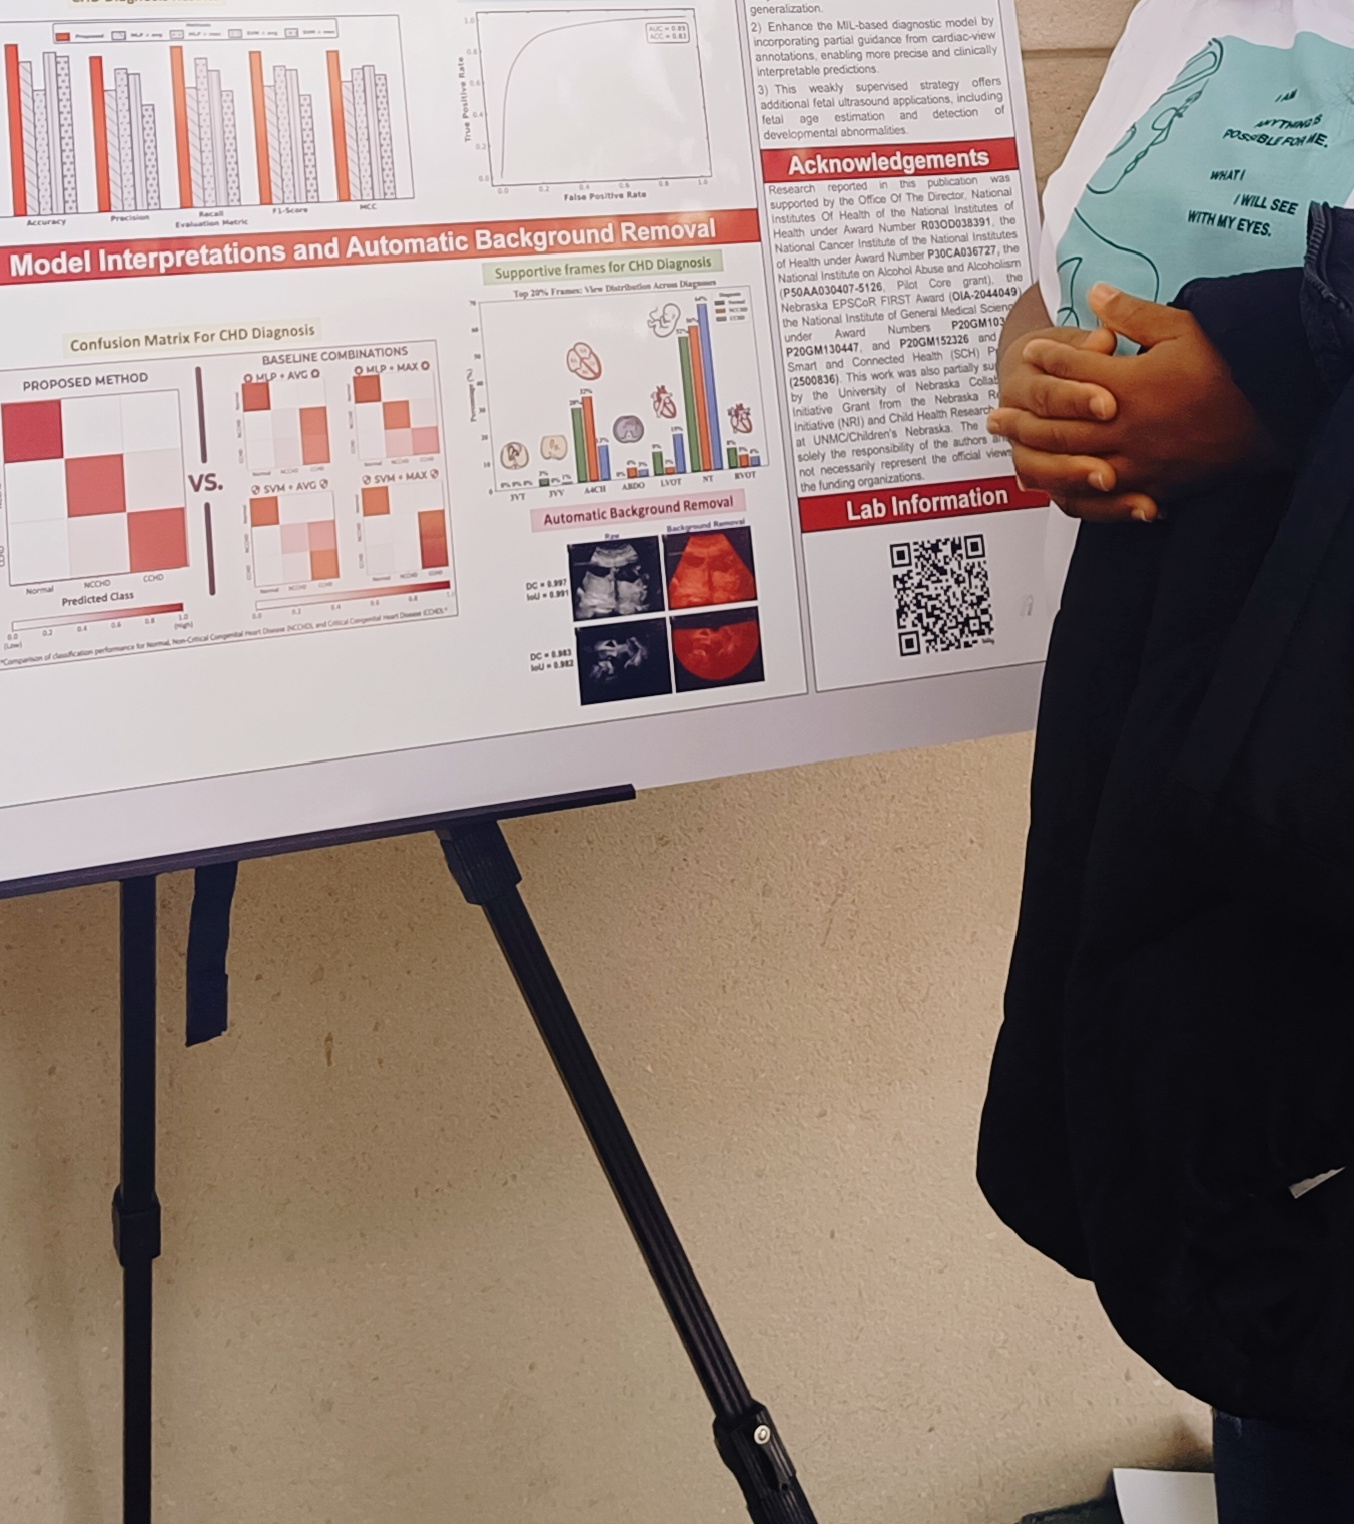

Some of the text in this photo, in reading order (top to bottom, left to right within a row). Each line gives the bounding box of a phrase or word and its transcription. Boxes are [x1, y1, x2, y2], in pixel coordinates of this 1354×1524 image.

[789, 149, 989, 175] Acknowledgements
[1210, 170, 1241, 180] WHAT
[1233, 194, 1298, 215] I WILL SEE
[1188, 210, 1271, 237] WITH MY EYES.
[10, 219, 716, 277] Model Interpretations and Automatic Background Removal
[71, 324, 315, 352] Confusion Matrix For CHD Diagnosis
[900, 335, 969, 348] P20GM152326
[262, 347, 408, 365] BASELINE COMBINATIONS
[23, 372, 148, 391] PROPOSED METHOD
[188, 474, 223, 492] VS.
[847, 488, 1009, 522] Lab Information
